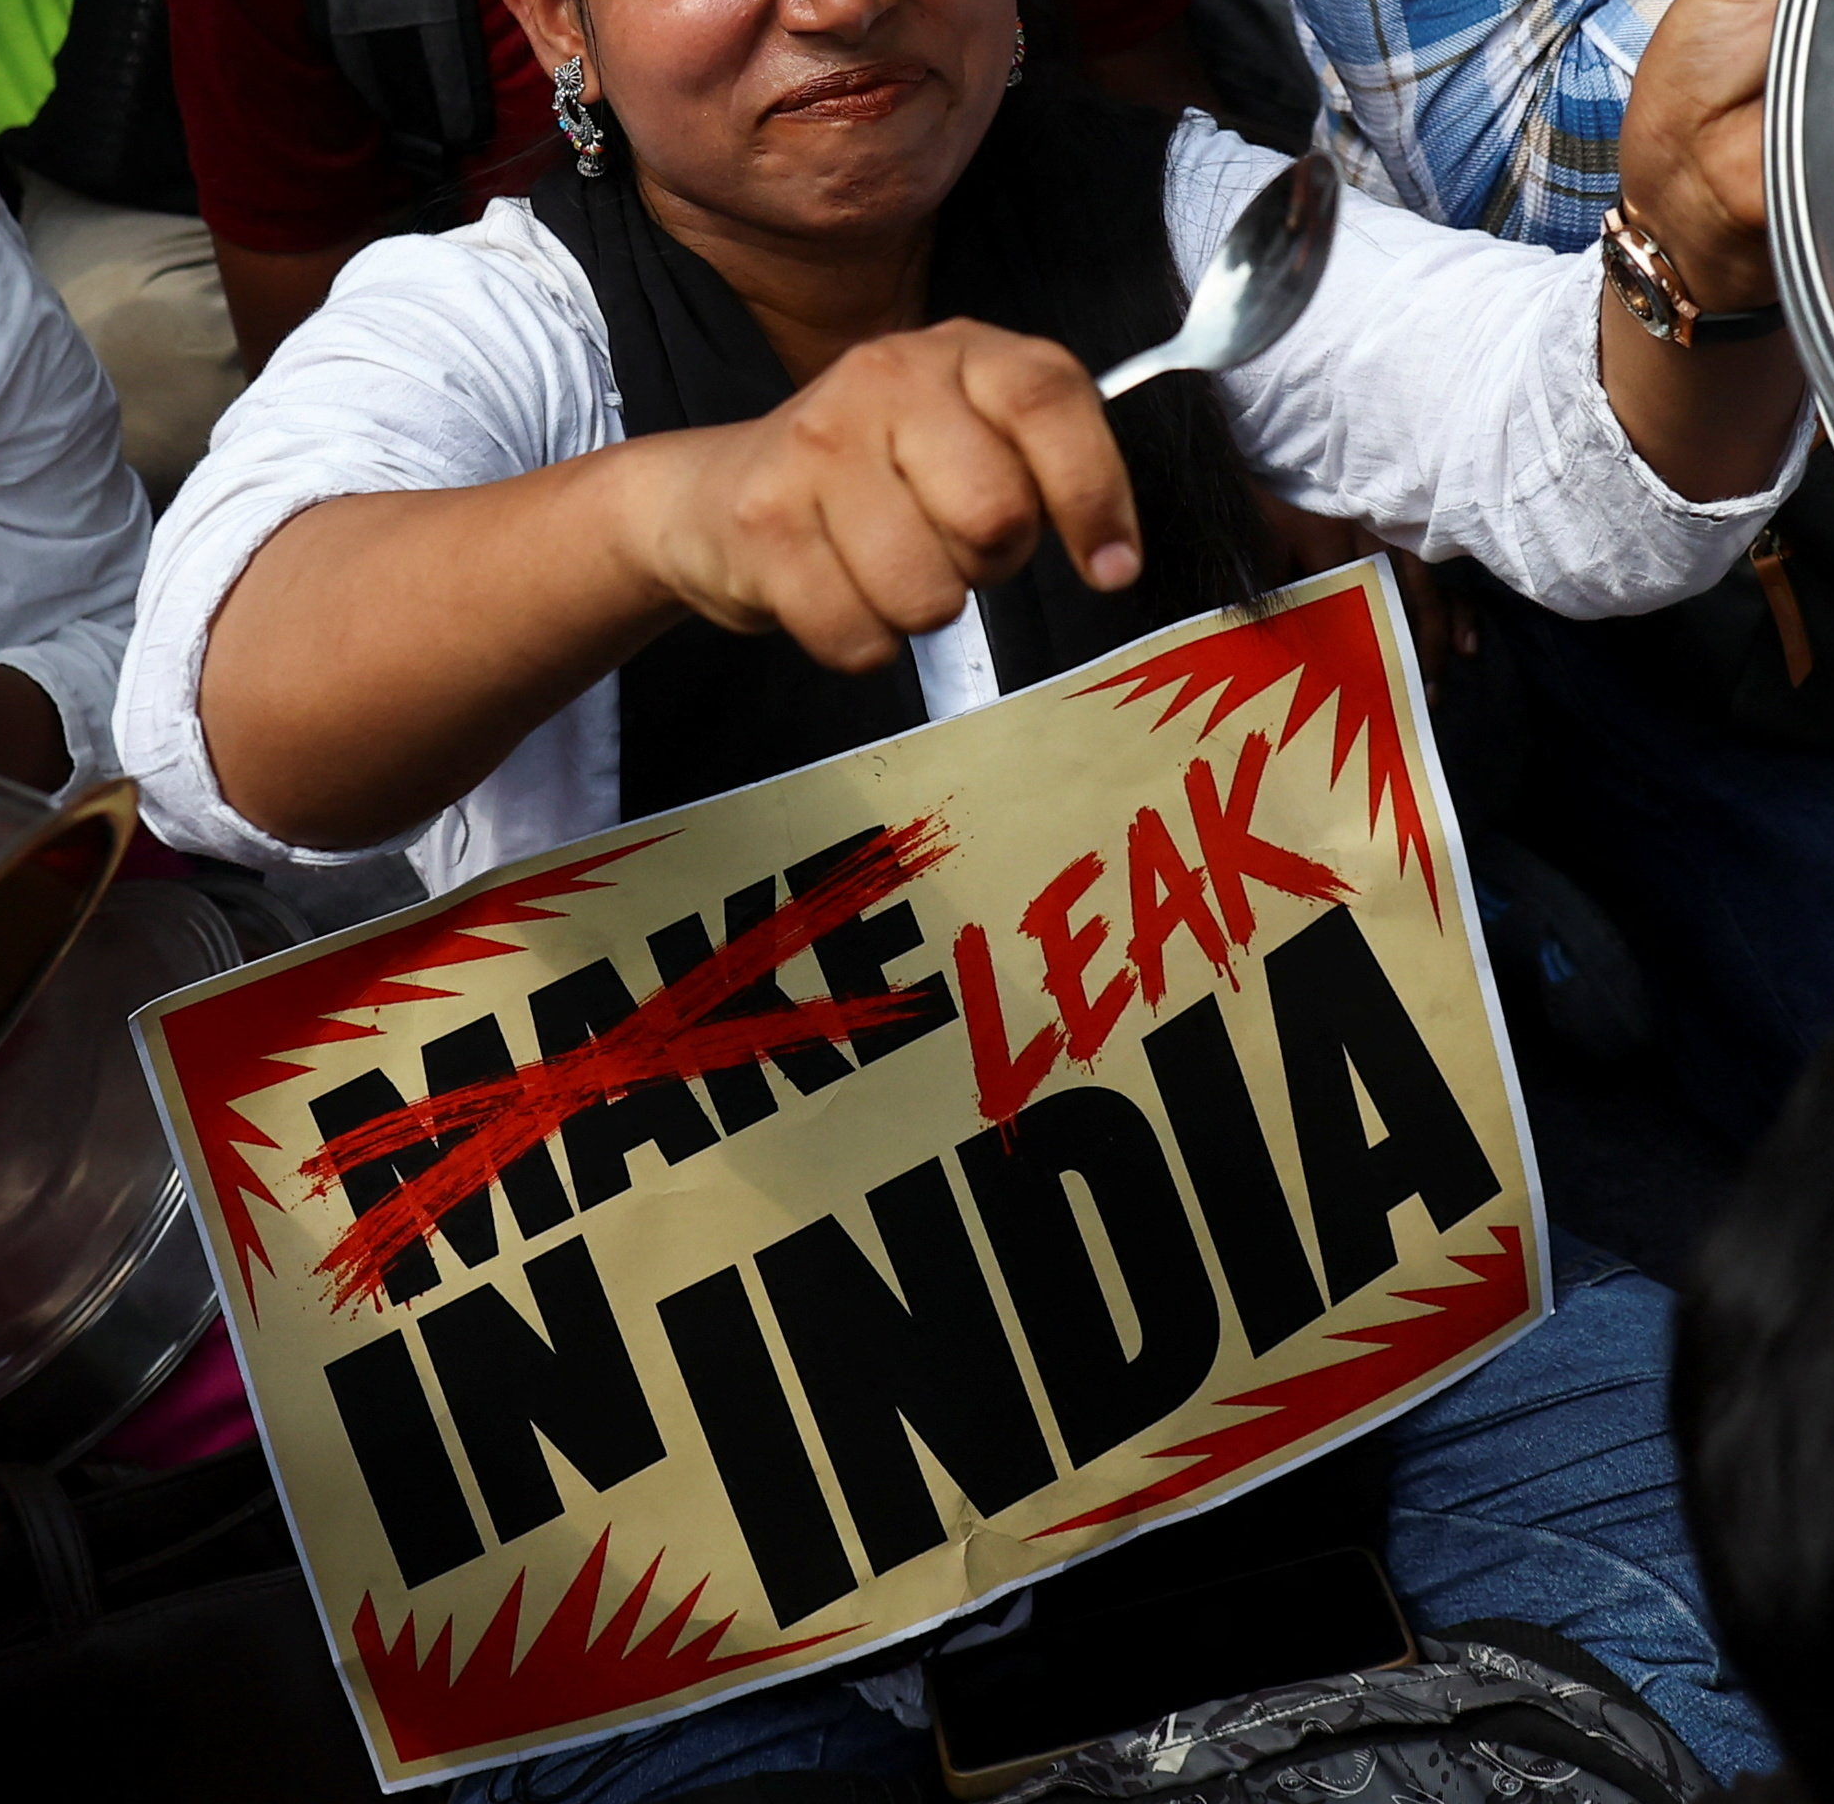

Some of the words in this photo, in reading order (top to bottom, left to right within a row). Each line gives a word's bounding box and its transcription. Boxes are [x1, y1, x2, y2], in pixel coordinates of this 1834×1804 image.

[308, 823, 959, 1300] MAKE
[953, 732, 1357, 1141] LEAK
[323, 1234, 667, 1591] IN
[656, 902, 1504, 1630] INDIA
